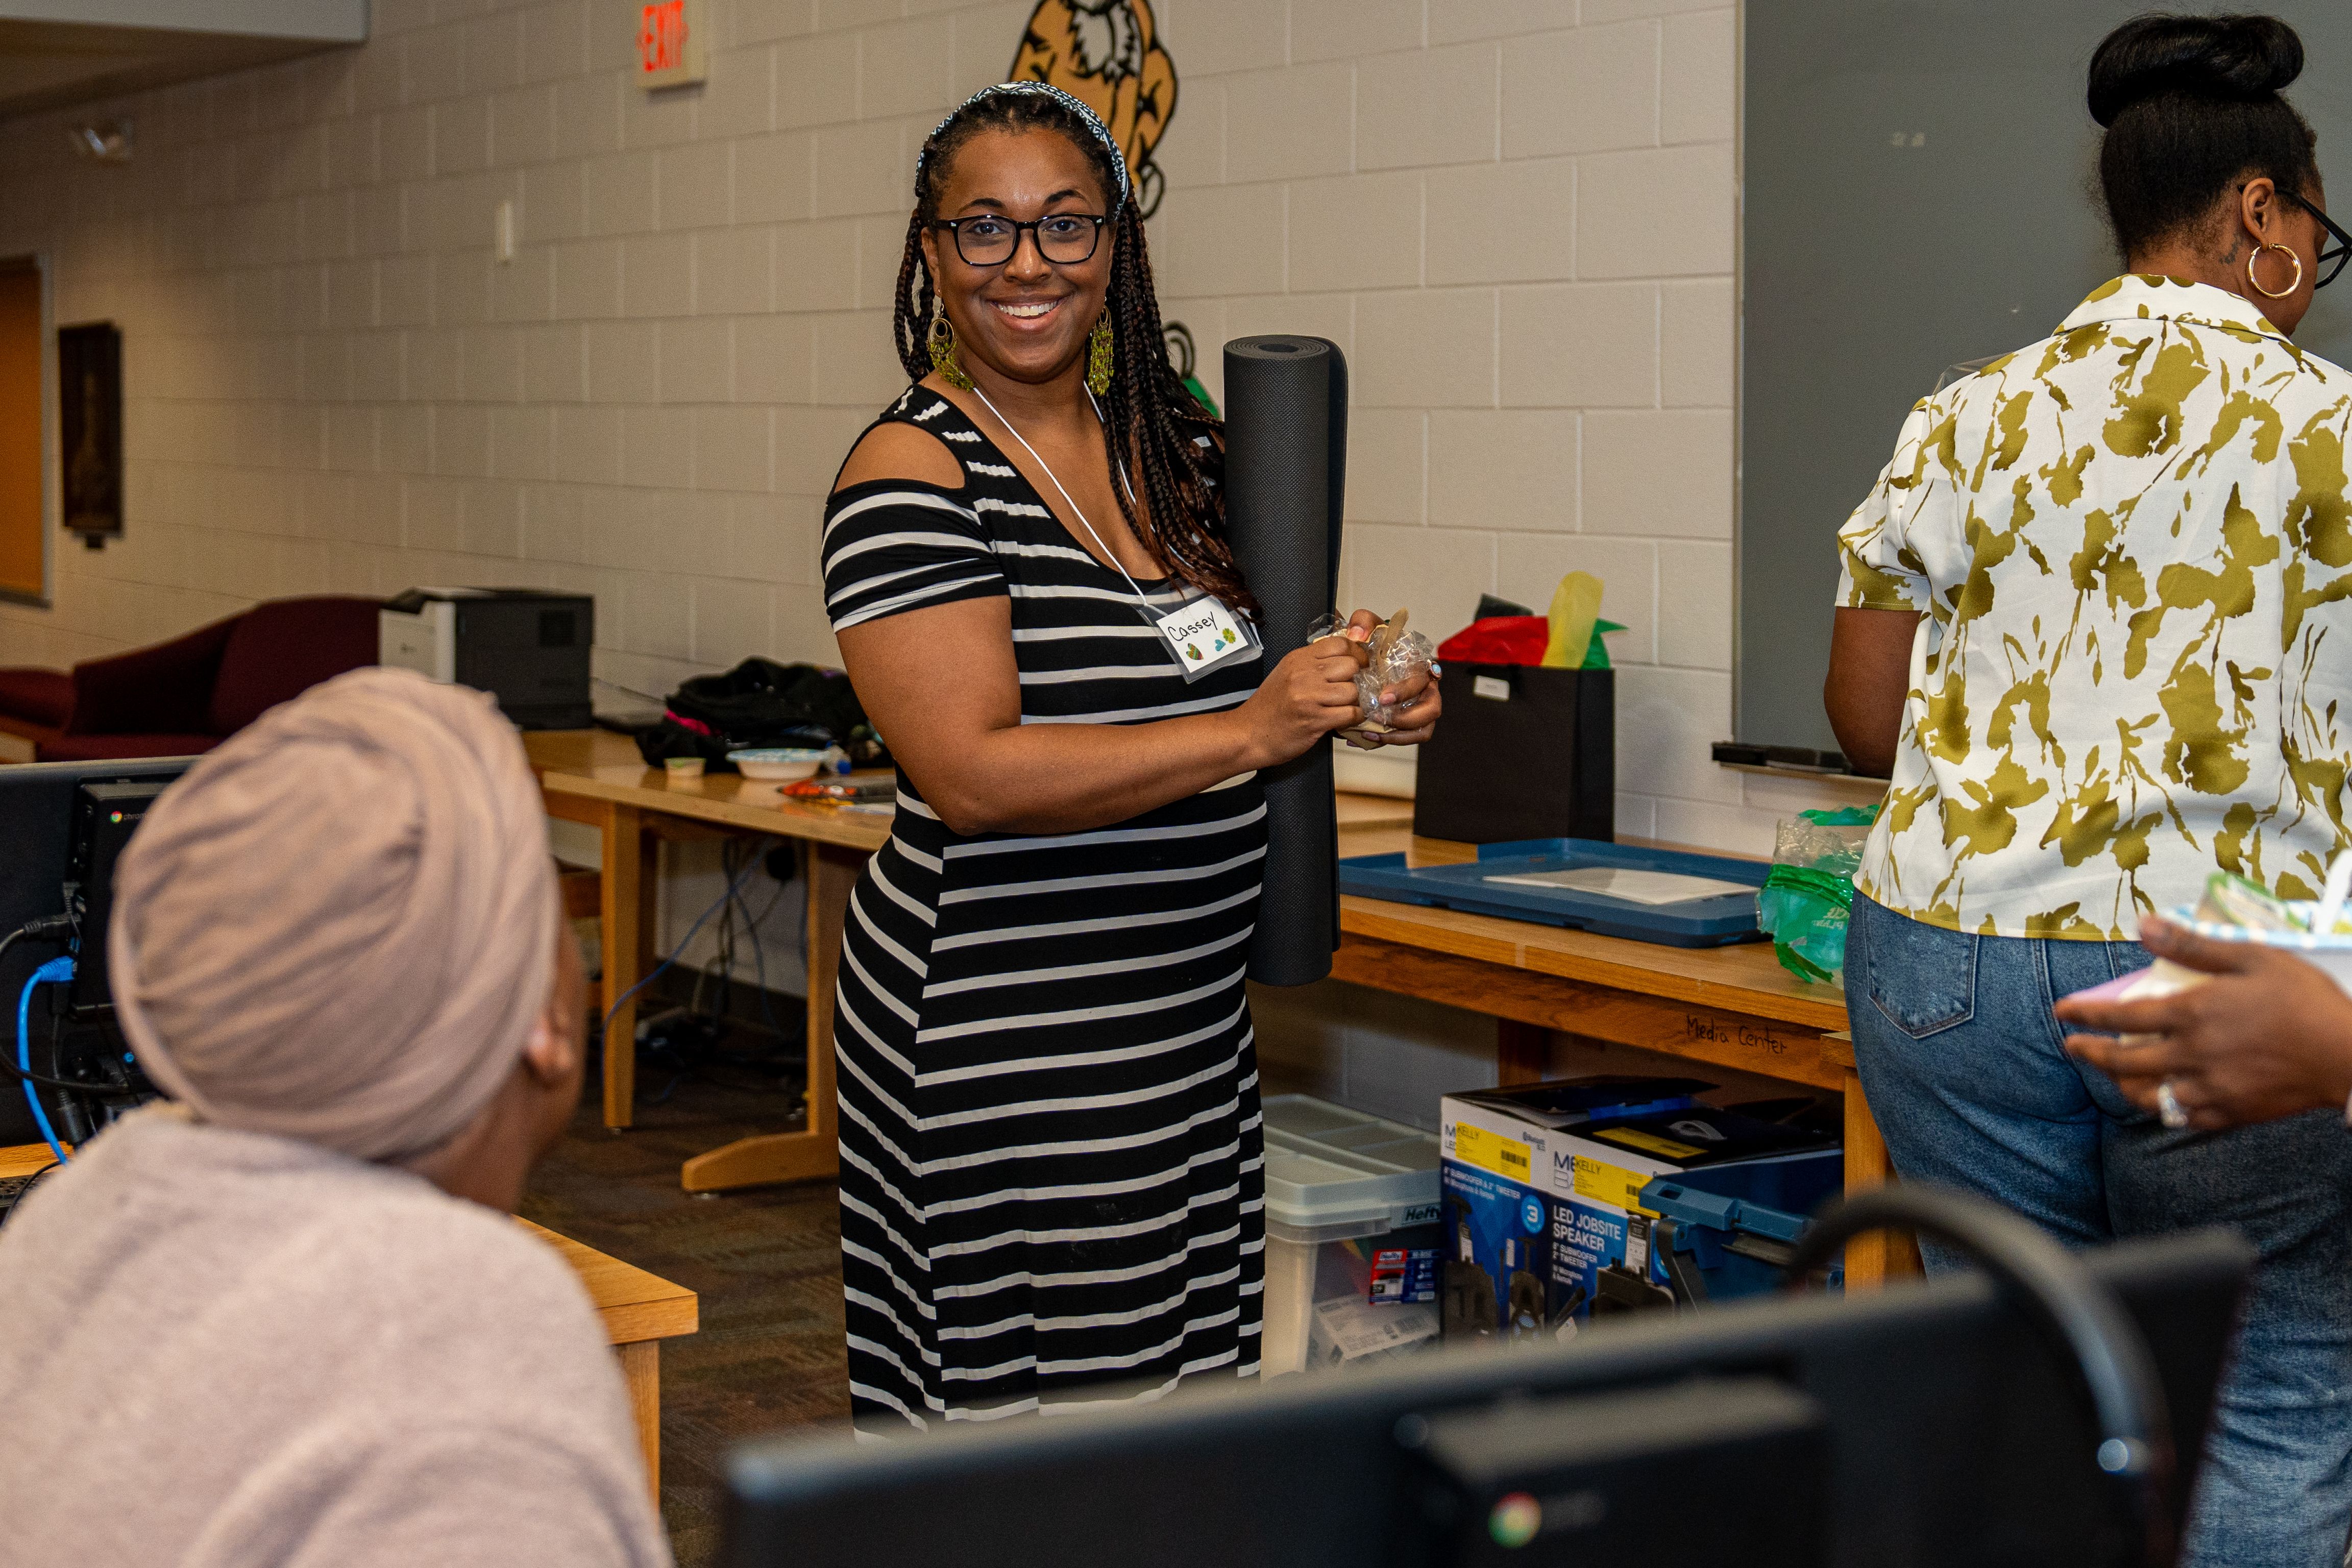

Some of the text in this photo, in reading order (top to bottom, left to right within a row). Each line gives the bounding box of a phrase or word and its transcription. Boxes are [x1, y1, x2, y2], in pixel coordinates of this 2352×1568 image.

[1168, 611, 1218, 642] Cassey
[1686, 1013, 1787, 1054] Media Center
[1576, 1159, 1601, 1175] KELLY
[1527, 1204, 1538, 1223] 3
[1553, 1205, 1622, 1241] LED JOBSITE
[1553, 1222, 1605, 1253] SPEAKER
[1560, 1244, 1598, 1264] SUBWOOFER
[1560, 1253, 1588, 1269] TWEETER
